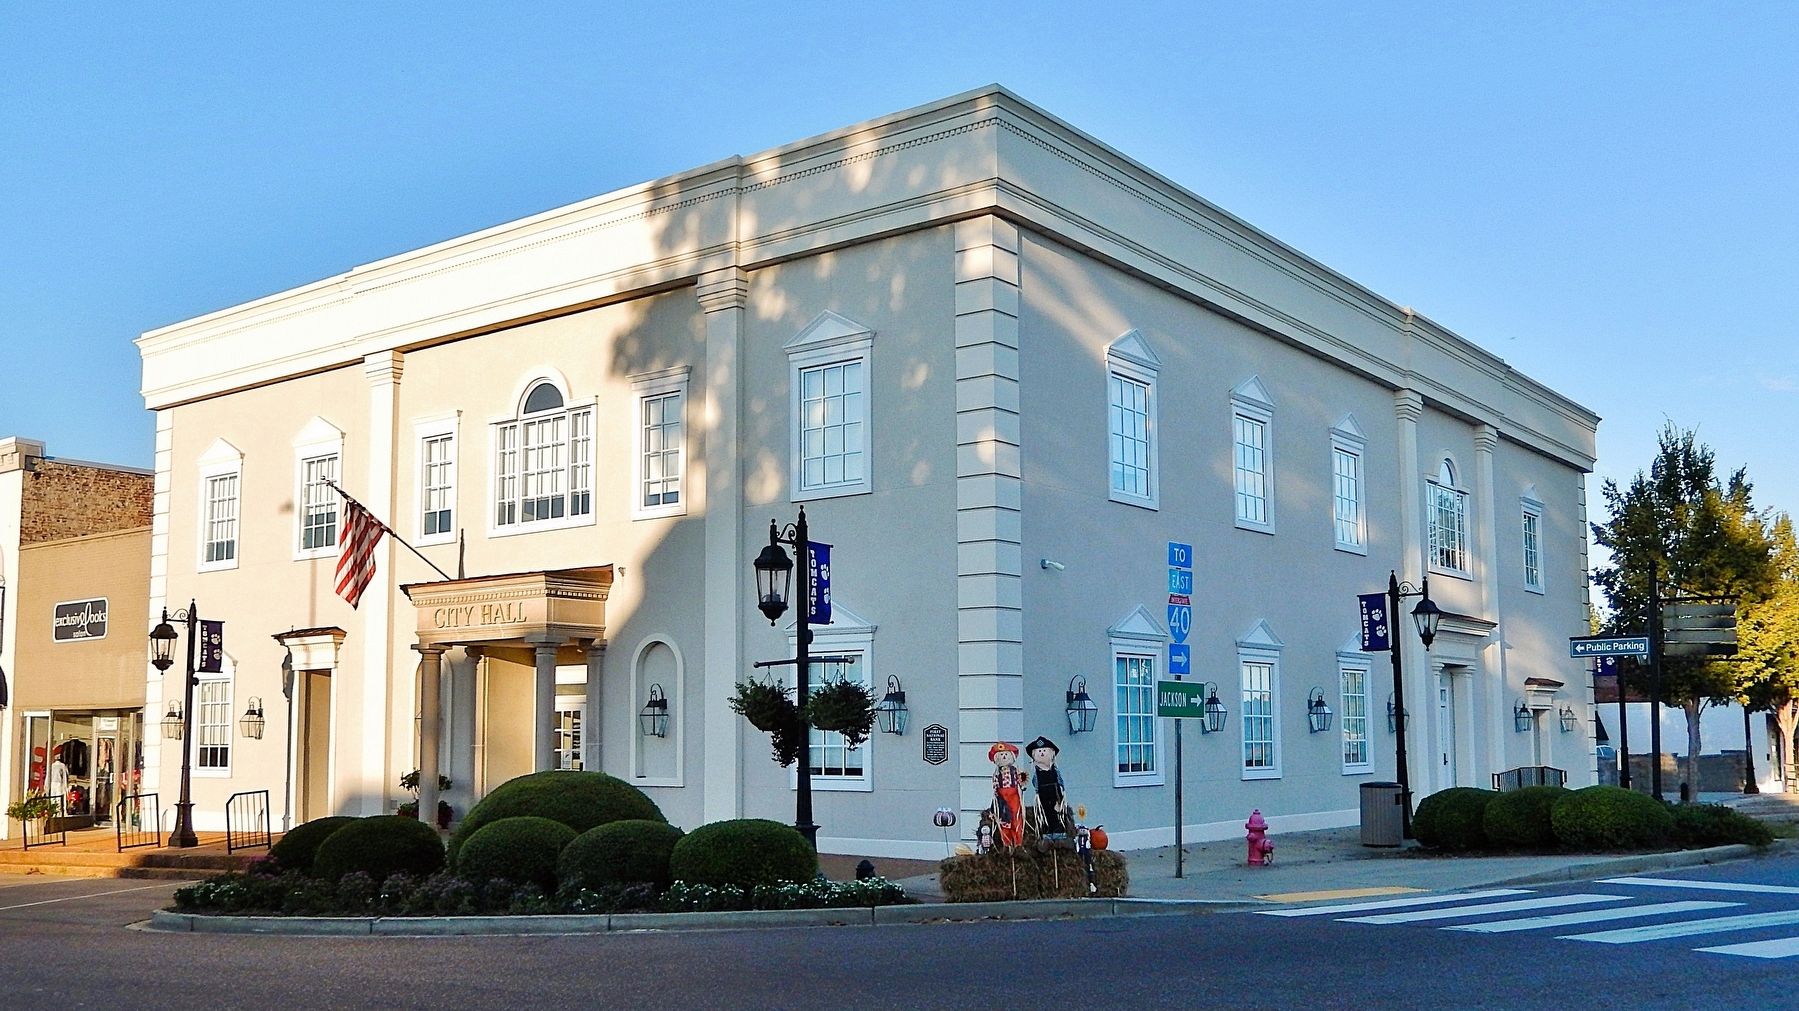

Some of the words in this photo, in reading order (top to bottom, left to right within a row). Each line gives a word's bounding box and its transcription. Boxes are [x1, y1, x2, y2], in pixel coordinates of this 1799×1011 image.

[1174, 547, 1186, 563] TO
[810, 549, 818, 616] TOMCATS
[1172, 574, 1189, 590] EAST
[434, 605, 475, 629] CITY
[480, 602, 528, 626] HALL
[1170, 607, 1190, 634] 40
[1361, 601, 1370, 647] TOMCATS
[1585, 643, 1612, 653] Public
[1613, 640, 1645, 653] Parking
[1159, 691, 1187, 708] JACKSON
